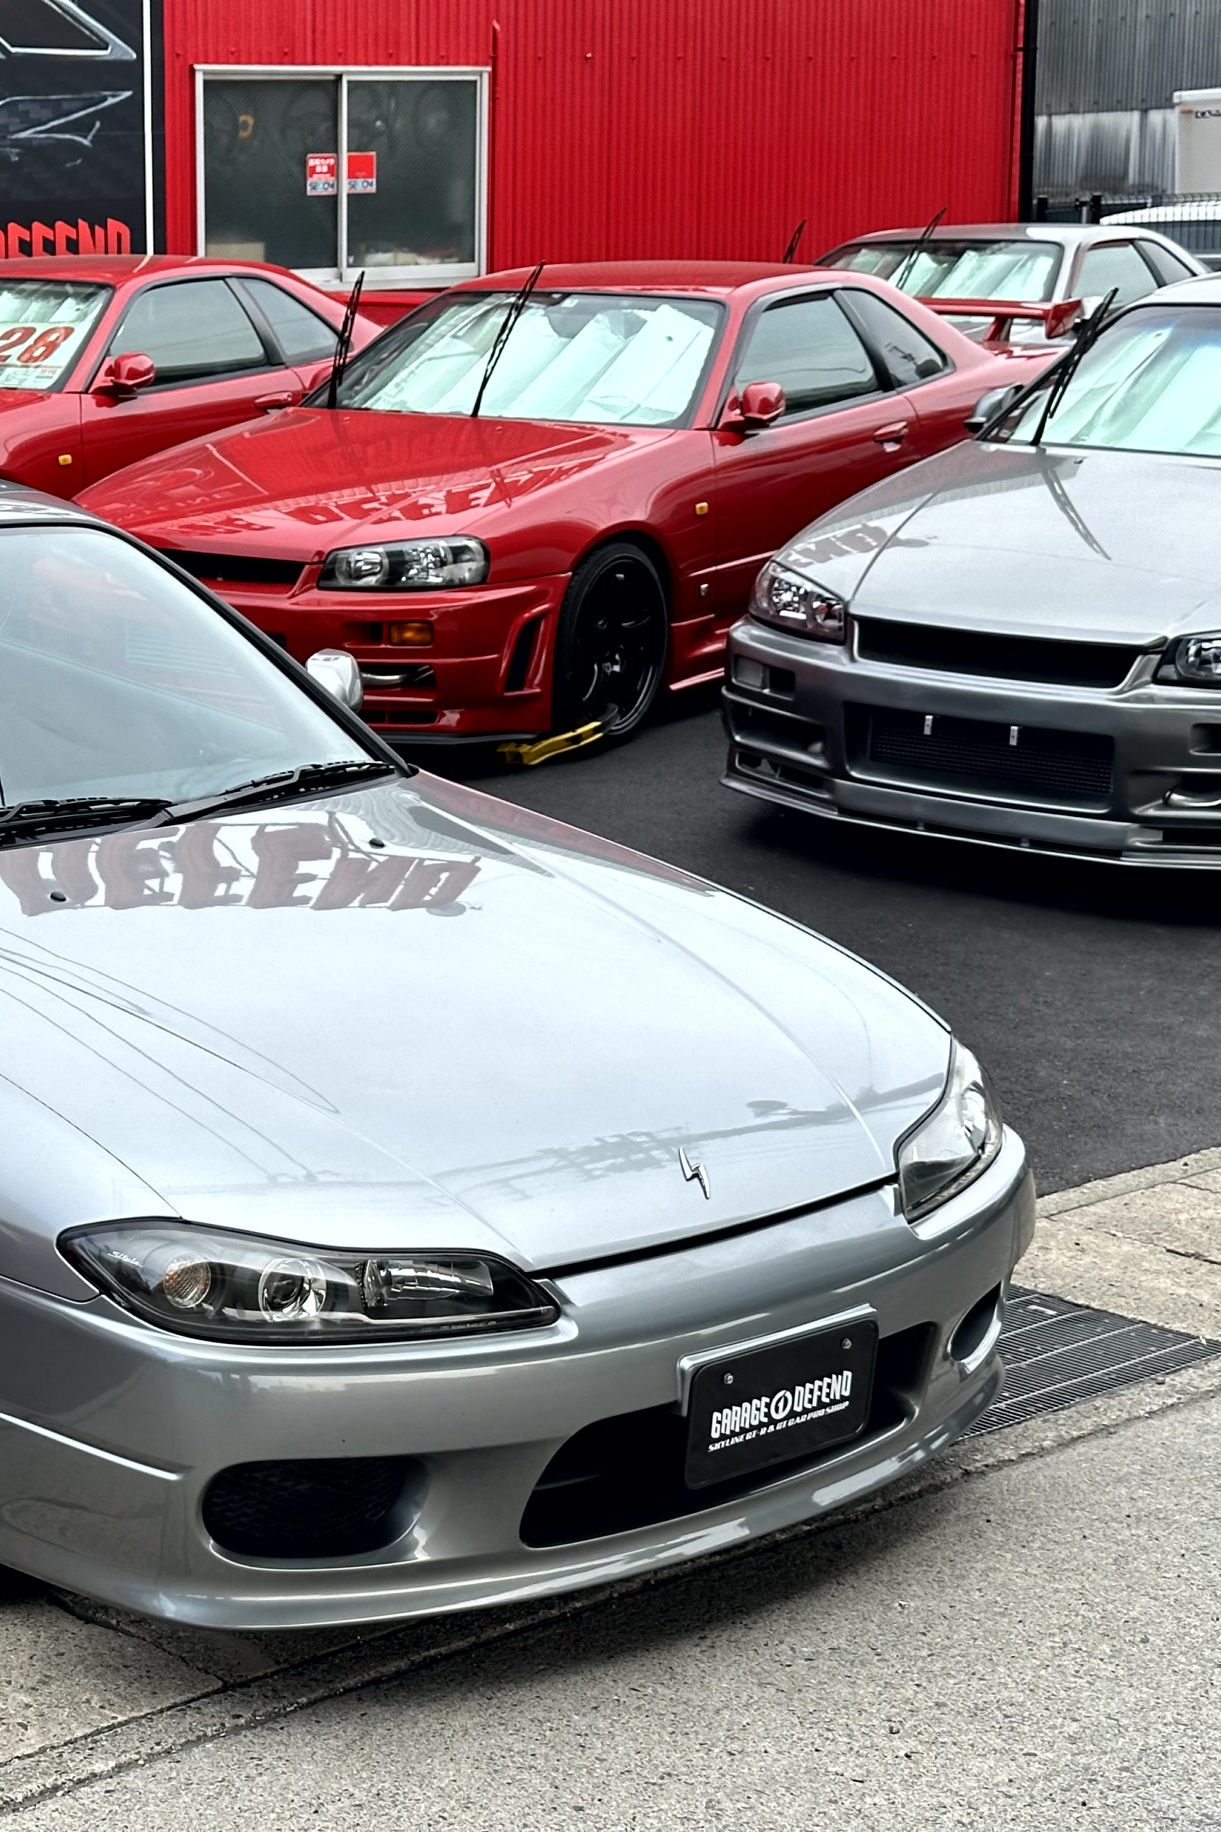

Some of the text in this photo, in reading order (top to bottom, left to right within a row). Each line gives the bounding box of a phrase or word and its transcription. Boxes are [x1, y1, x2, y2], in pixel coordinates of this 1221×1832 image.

[708, 1433, 746, 1453] SKYLINE
[745, 1427, 767, 1440] GT-R
[776, 1420, 789, 1431] GT
[807, 1408, 825, 1421] PRO
[825, 1400, 850, 1414] SHOP
[710, 1396, 771, 1439] GARAGE
[793, 1370, 853, 1412] DEFEND
